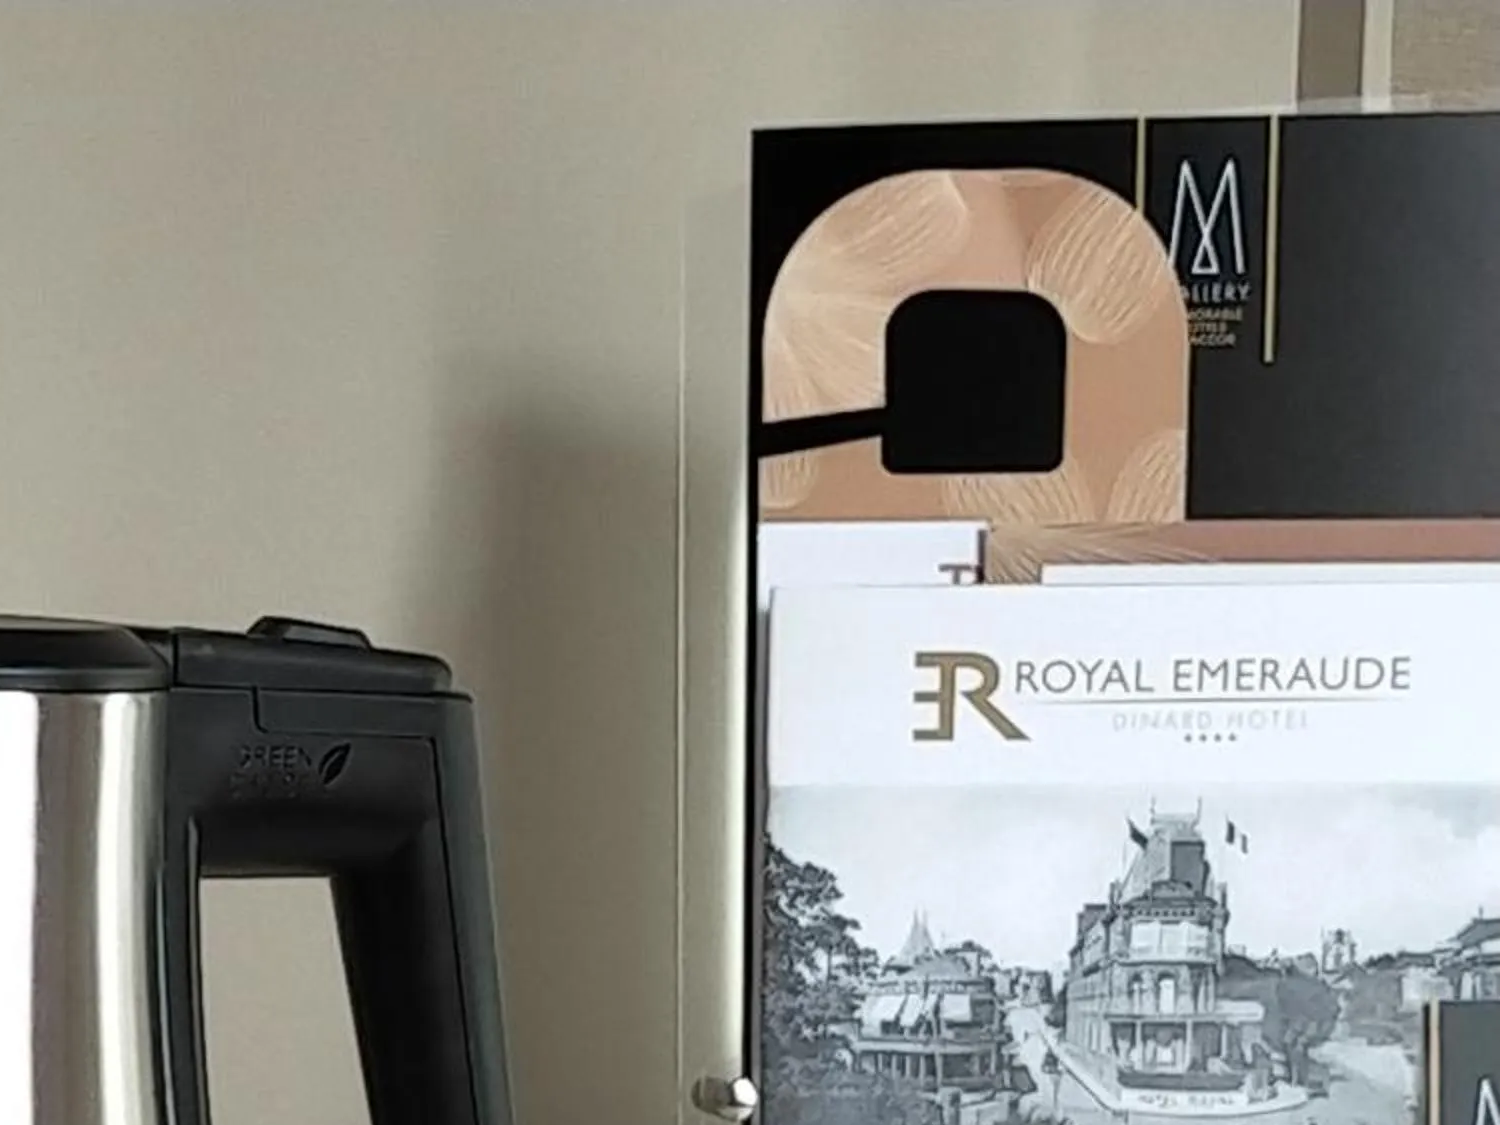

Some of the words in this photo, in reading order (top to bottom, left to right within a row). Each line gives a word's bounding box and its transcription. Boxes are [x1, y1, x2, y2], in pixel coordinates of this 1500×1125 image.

[1178, 282, 1251, 303] ALLERY
[1014, 660, 1155, 695] ROYAL
[1172, 656, 1411, 693] EMERAUDE
[1227, 710, 1308, 731] HOTEL
